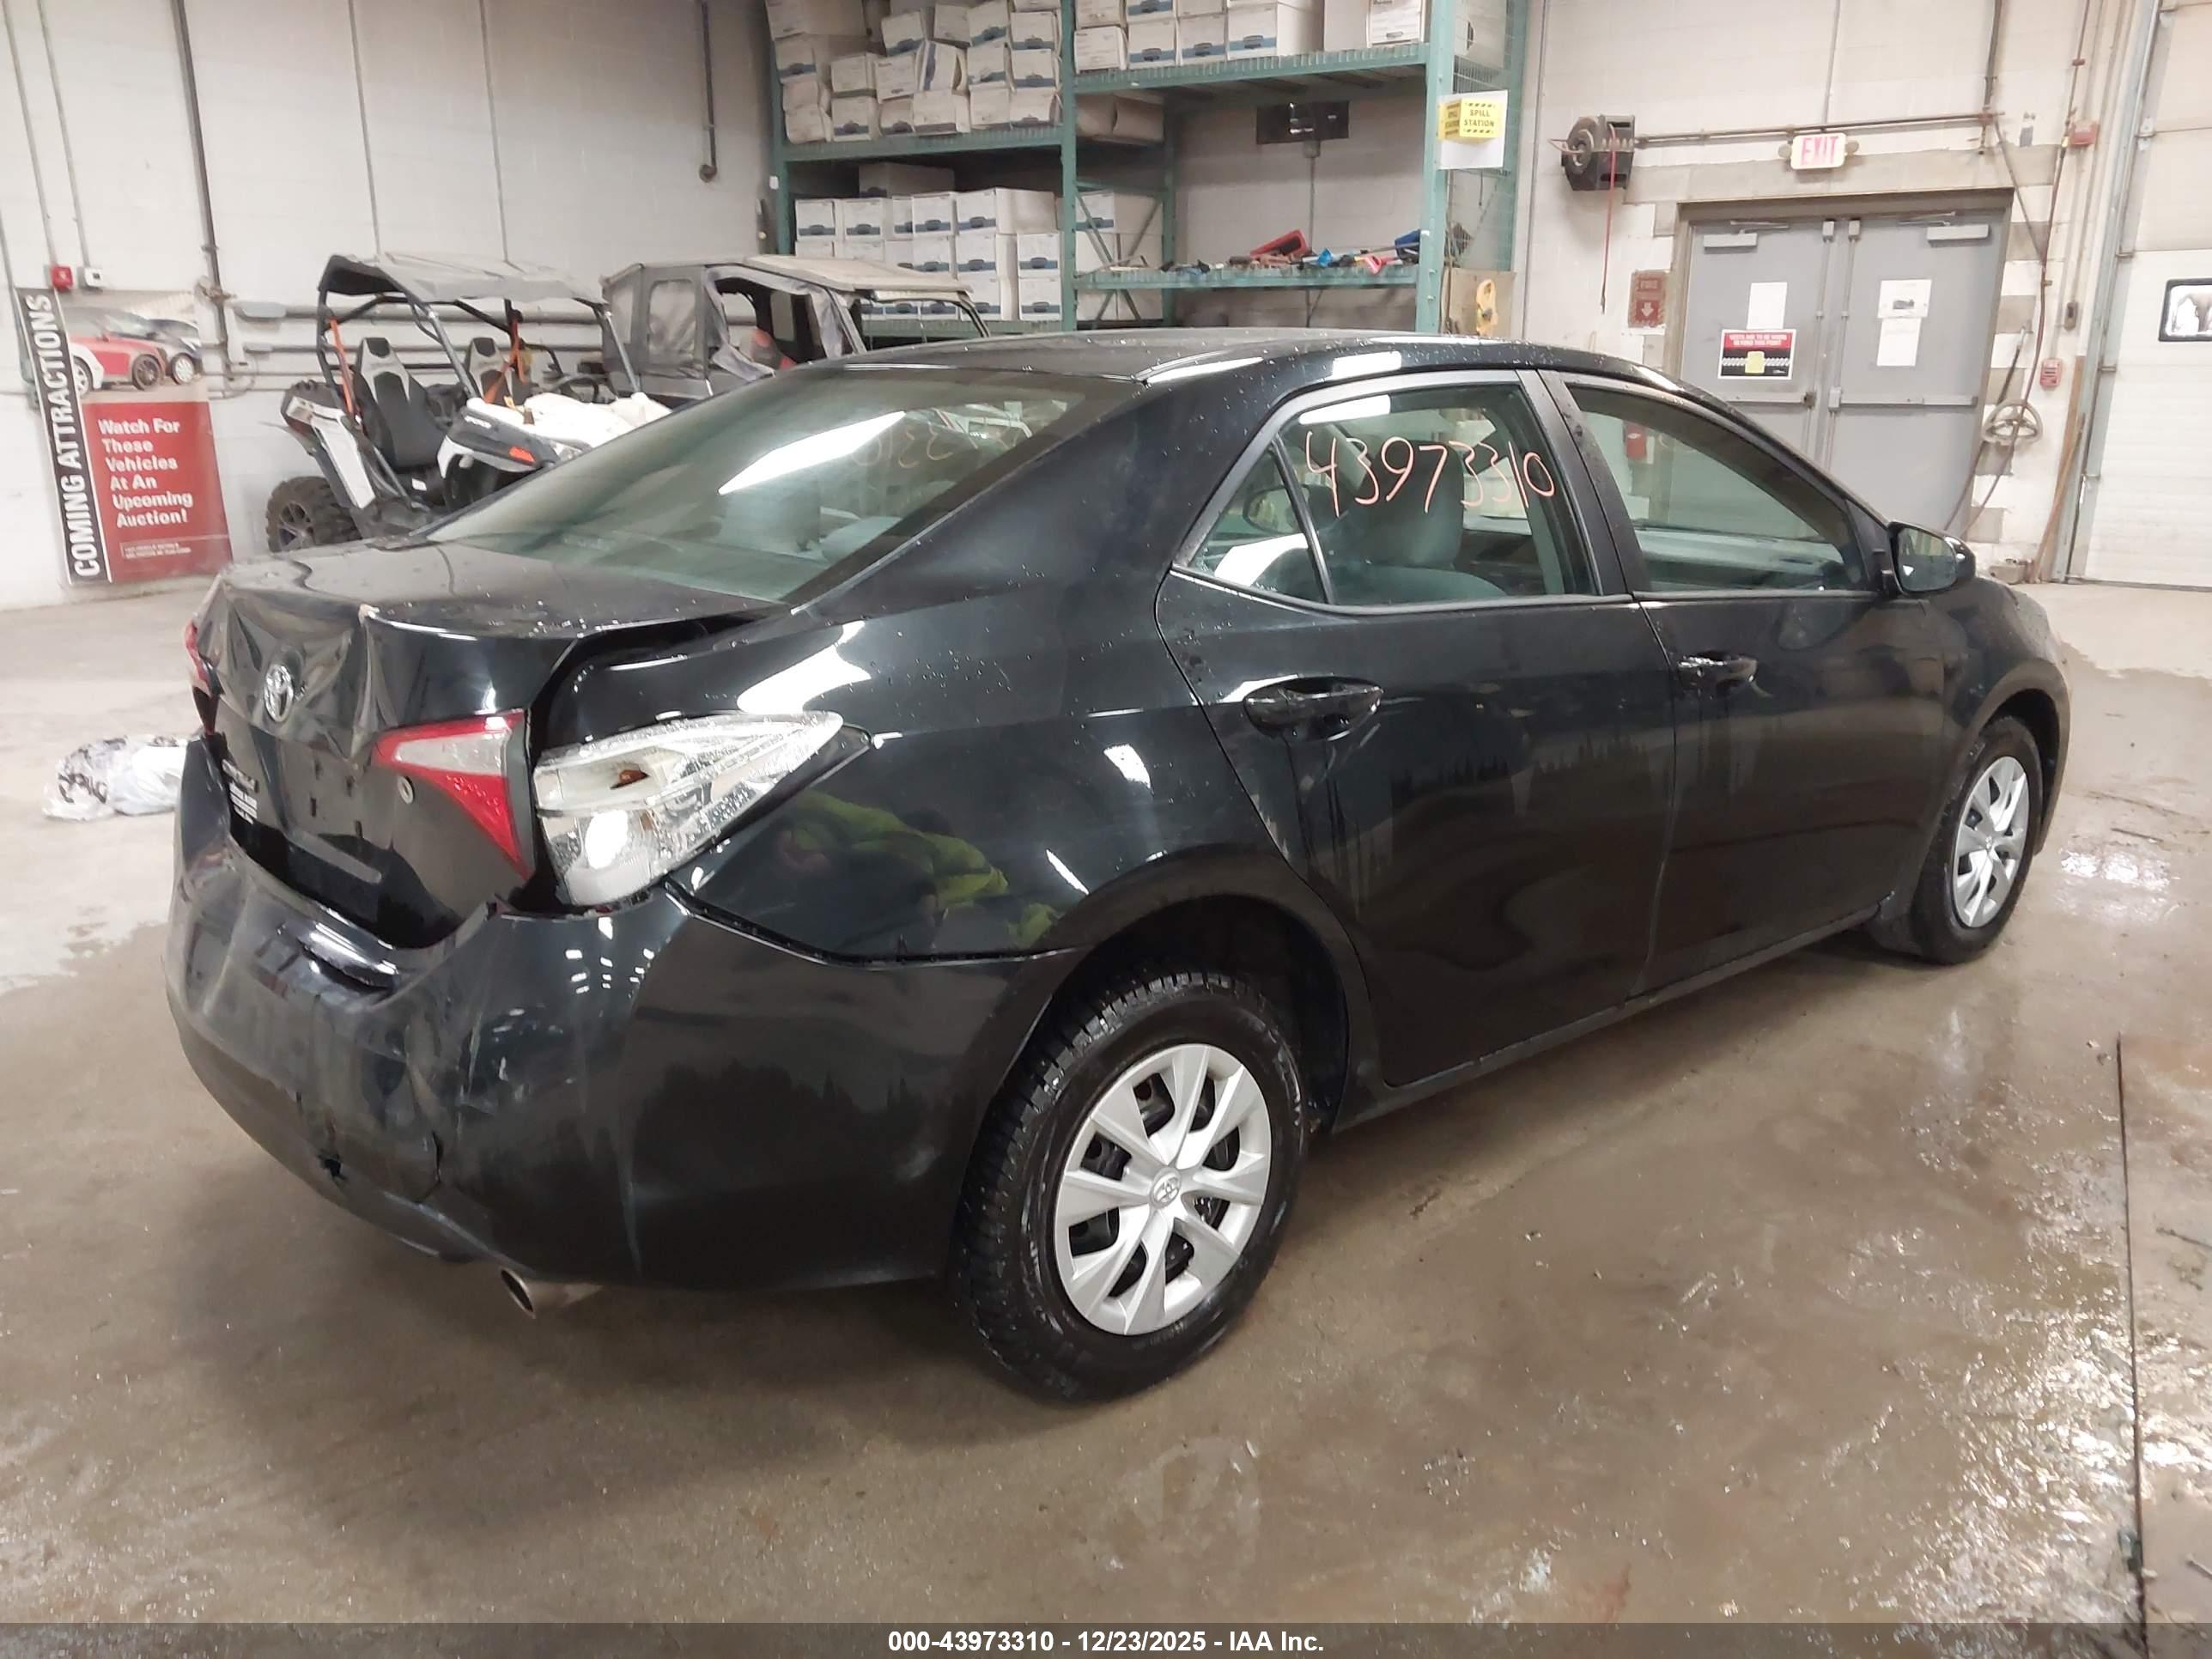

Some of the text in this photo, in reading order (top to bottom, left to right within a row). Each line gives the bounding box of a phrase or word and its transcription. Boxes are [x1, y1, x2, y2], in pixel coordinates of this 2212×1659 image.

[1469, 109, 1491, 118] SPILL
[1463, 118, 1495, 128] STATION
[1801, 136, 1839, 166] EXIT
[98, 417, 180, 434] Watch For
[25, 295, 100, 578] COMING ATTRACTIONS
[101, 437, 154, 454] These
[105, 454, 179, 472] Vehicles
[110, 473, 158, 491] At An
[1306, 430, 1555, 517] 43973310
[112, 490, 193, 512] Upcoming
[116, 508, 188, 529] Auction!
